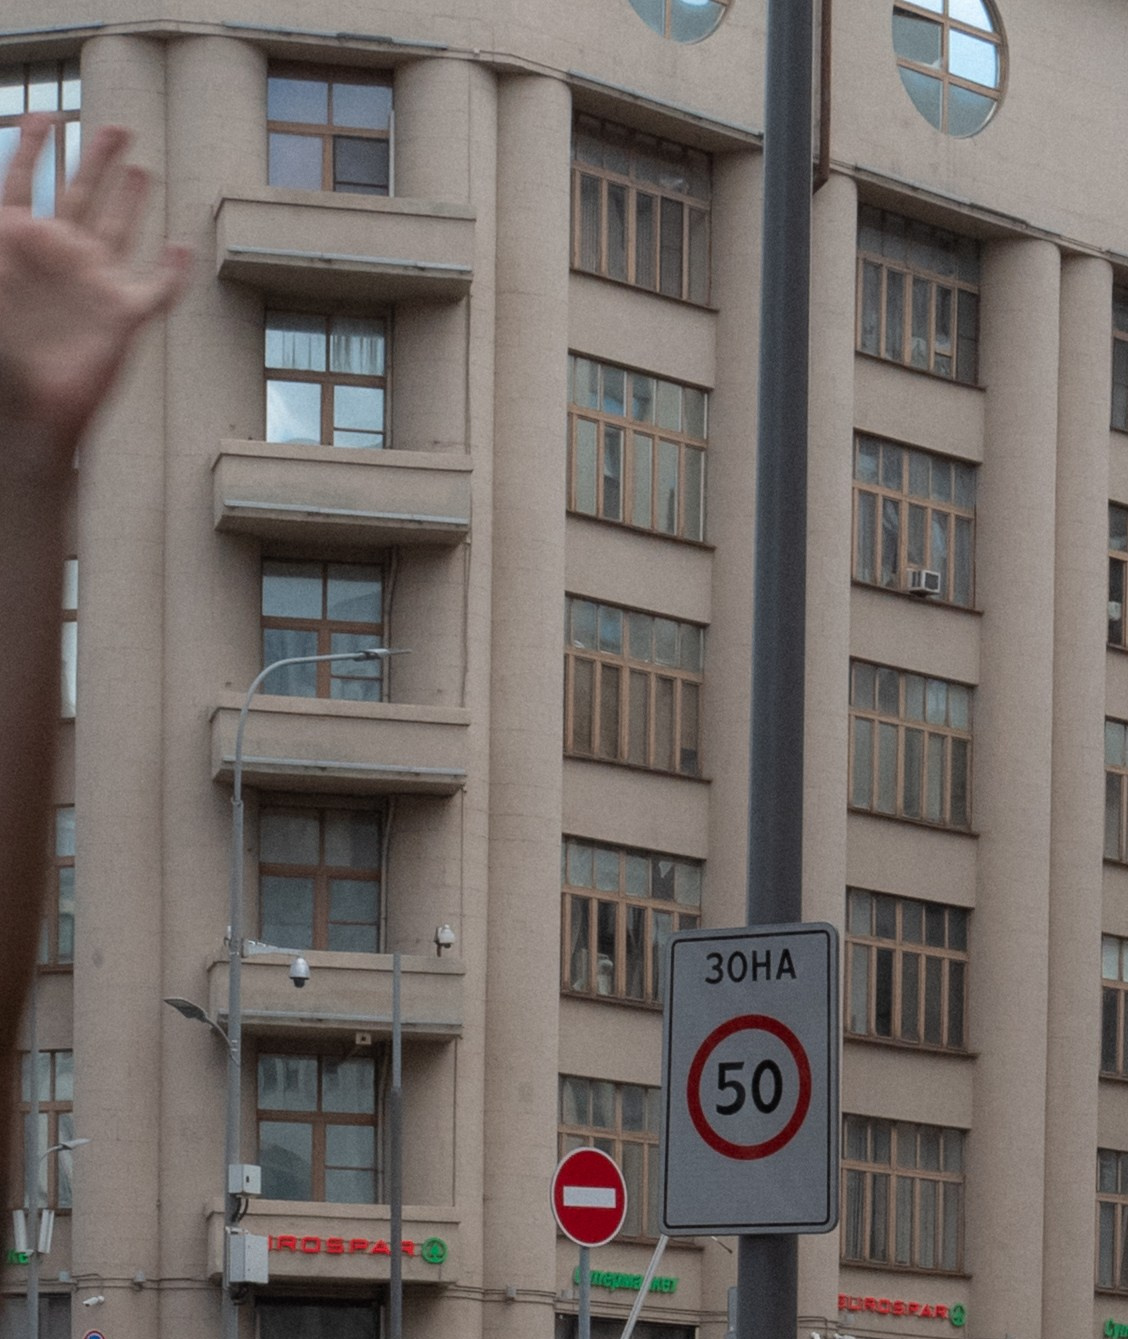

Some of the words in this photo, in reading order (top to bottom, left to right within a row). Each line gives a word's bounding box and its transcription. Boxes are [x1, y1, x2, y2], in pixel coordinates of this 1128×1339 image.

[705, 949, 797, 985] ЗОНА
[716, 1059, 783, 1116] 50
[268, 1234, 415, 1257] ROSPAR
[838, 1293, 949, 1319] EUROSPAR
